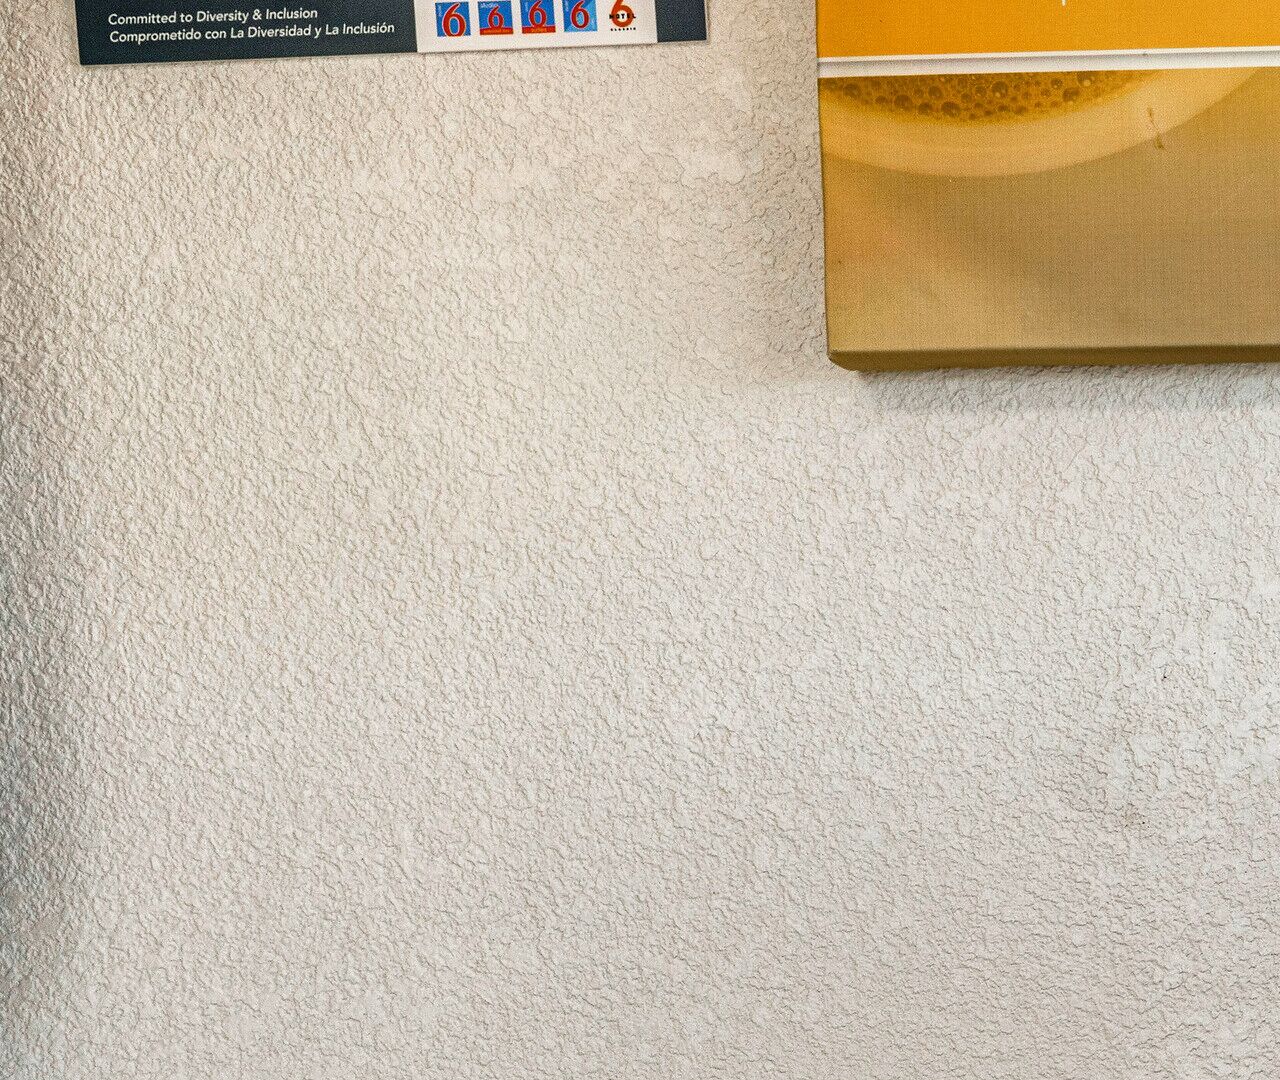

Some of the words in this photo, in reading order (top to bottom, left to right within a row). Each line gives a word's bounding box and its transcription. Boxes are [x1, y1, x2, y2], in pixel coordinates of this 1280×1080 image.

[108, 11, 177, 25] Committed
[180, 12, 193, 23] to
[196, 10, 250, 24] Diversity
[252, 9, 262, 20] &
[266, 7, 318, 20] Inclusion
[109, 28, 201, 45] Comprometido
[205, 30, 227, 39] con
[230, 27, 244, 39] La
[247, 24, 312, 38] Diversidad
[314, 27, 322, 39] y
[325, 24, 339, 35] La
[342, 22, 395, 35] Inclusión
